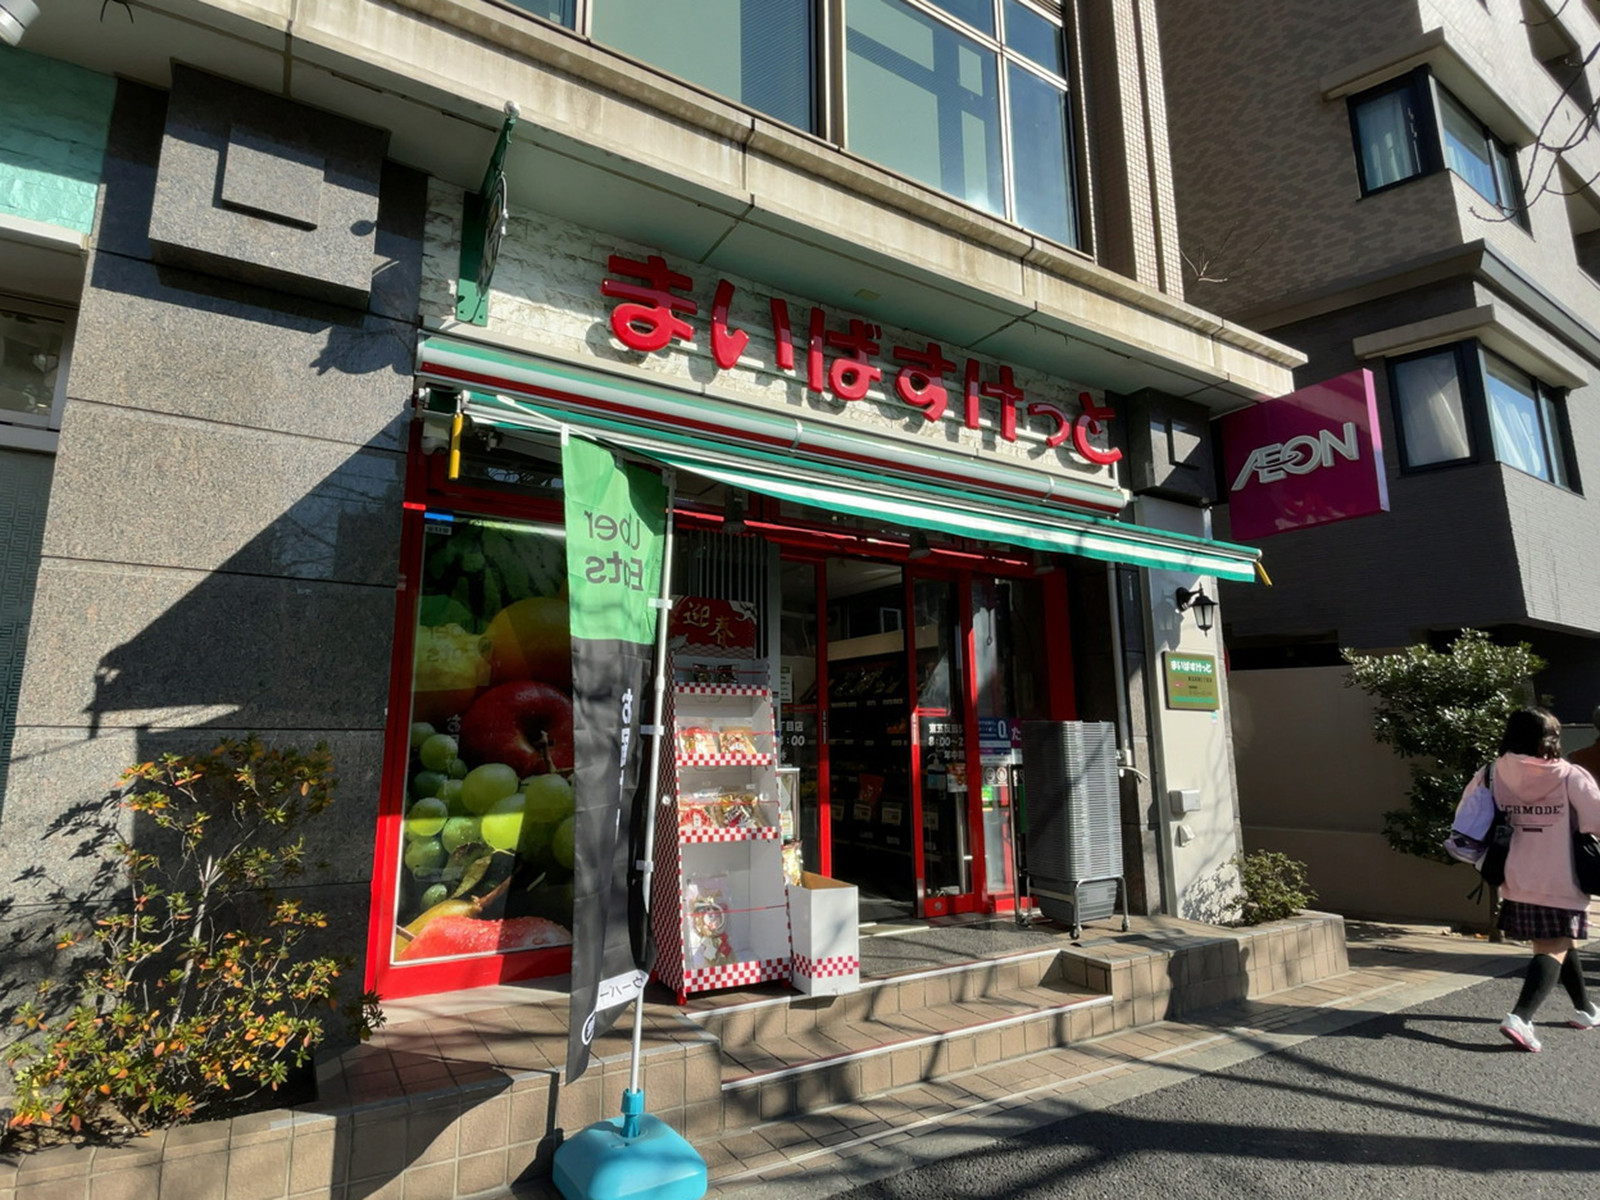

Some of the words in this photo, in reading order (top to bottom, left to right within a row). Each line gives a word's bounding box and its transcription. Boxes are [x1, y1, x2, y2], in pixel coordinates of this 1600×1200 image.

[601, 255, 1122, 465] まいばすけっと
